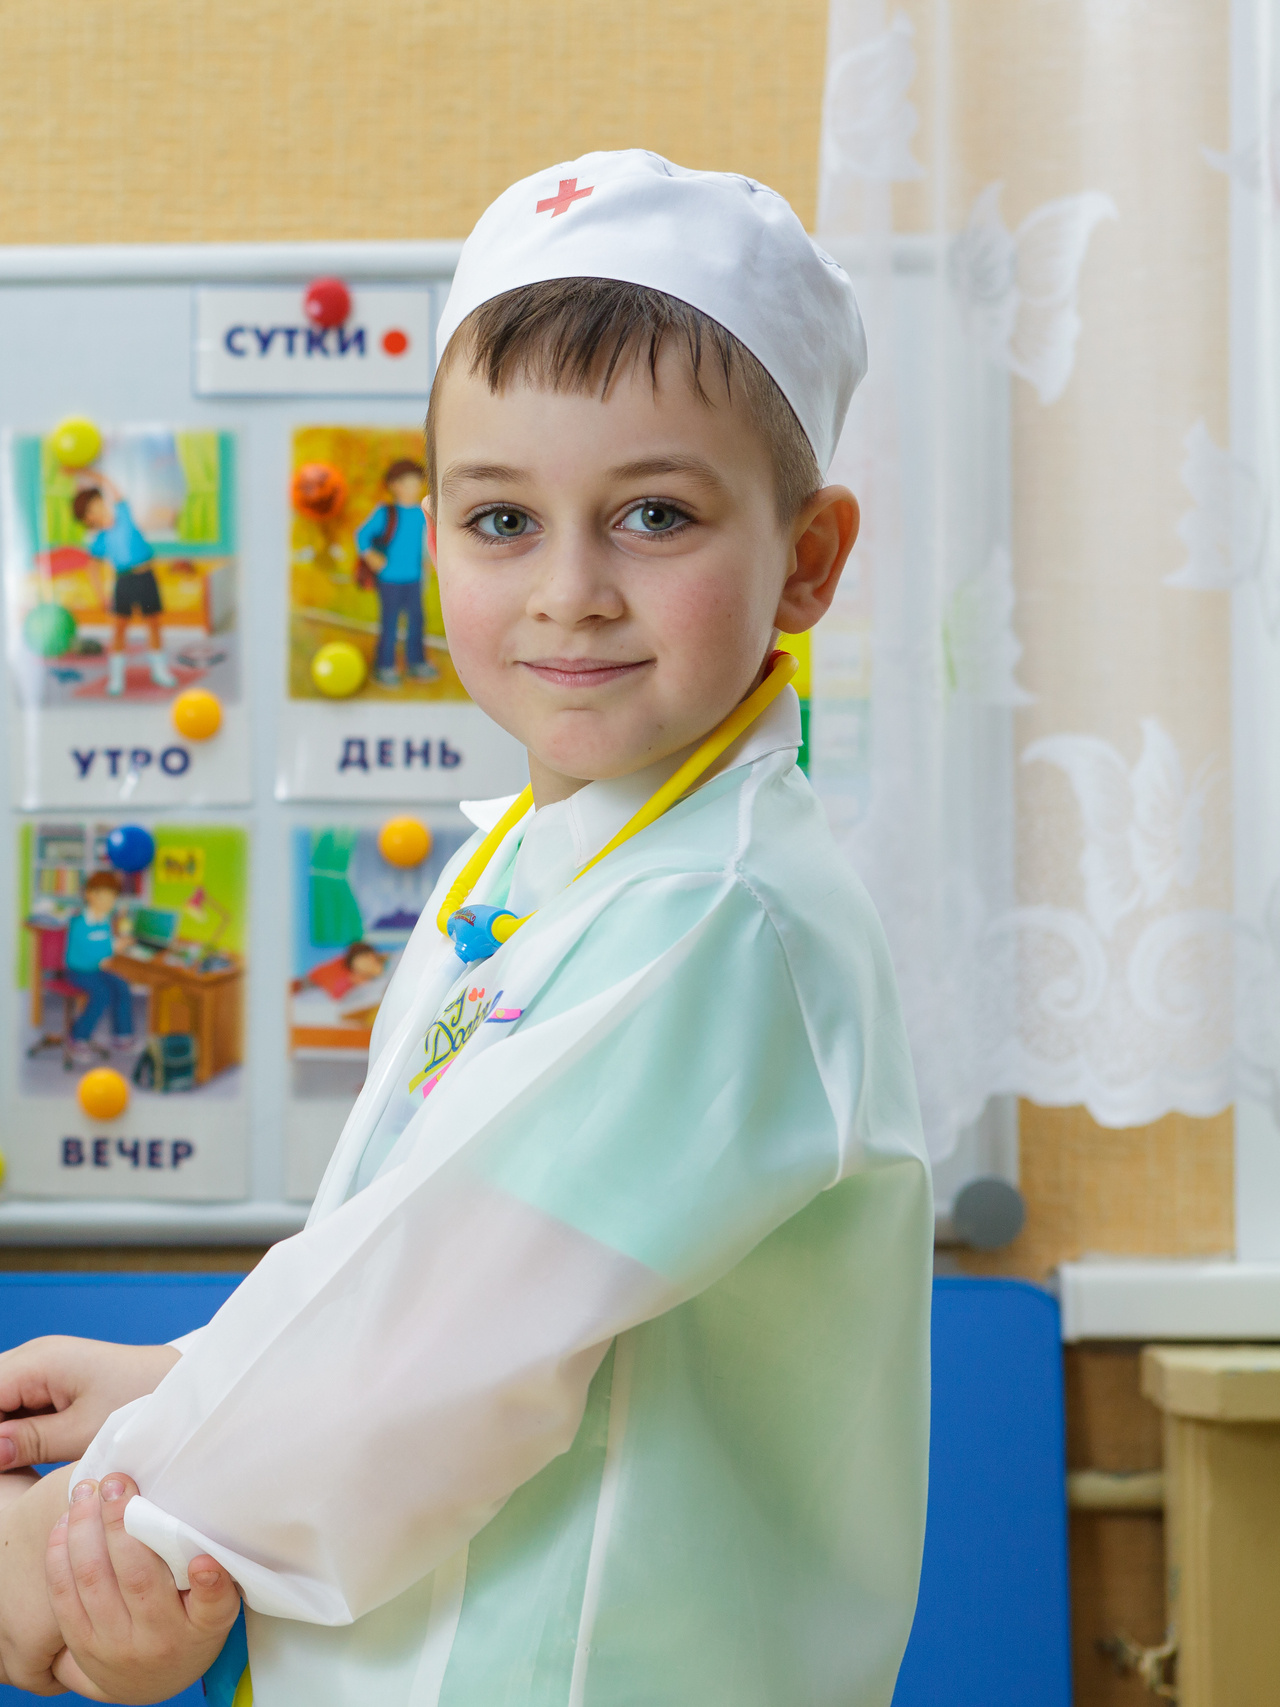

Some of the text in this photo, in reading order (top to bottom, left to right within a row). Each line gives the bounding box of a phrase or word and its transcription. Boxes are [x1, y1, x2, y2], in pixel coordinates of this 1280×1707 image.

[222, 326, 367, 359] СУТКИ
[70, 746, 192, 778] УТРО
[337, 737, 463, 772] ДЕНЬ
[60, 1137, 195, 1171] ВЕЧЕР
